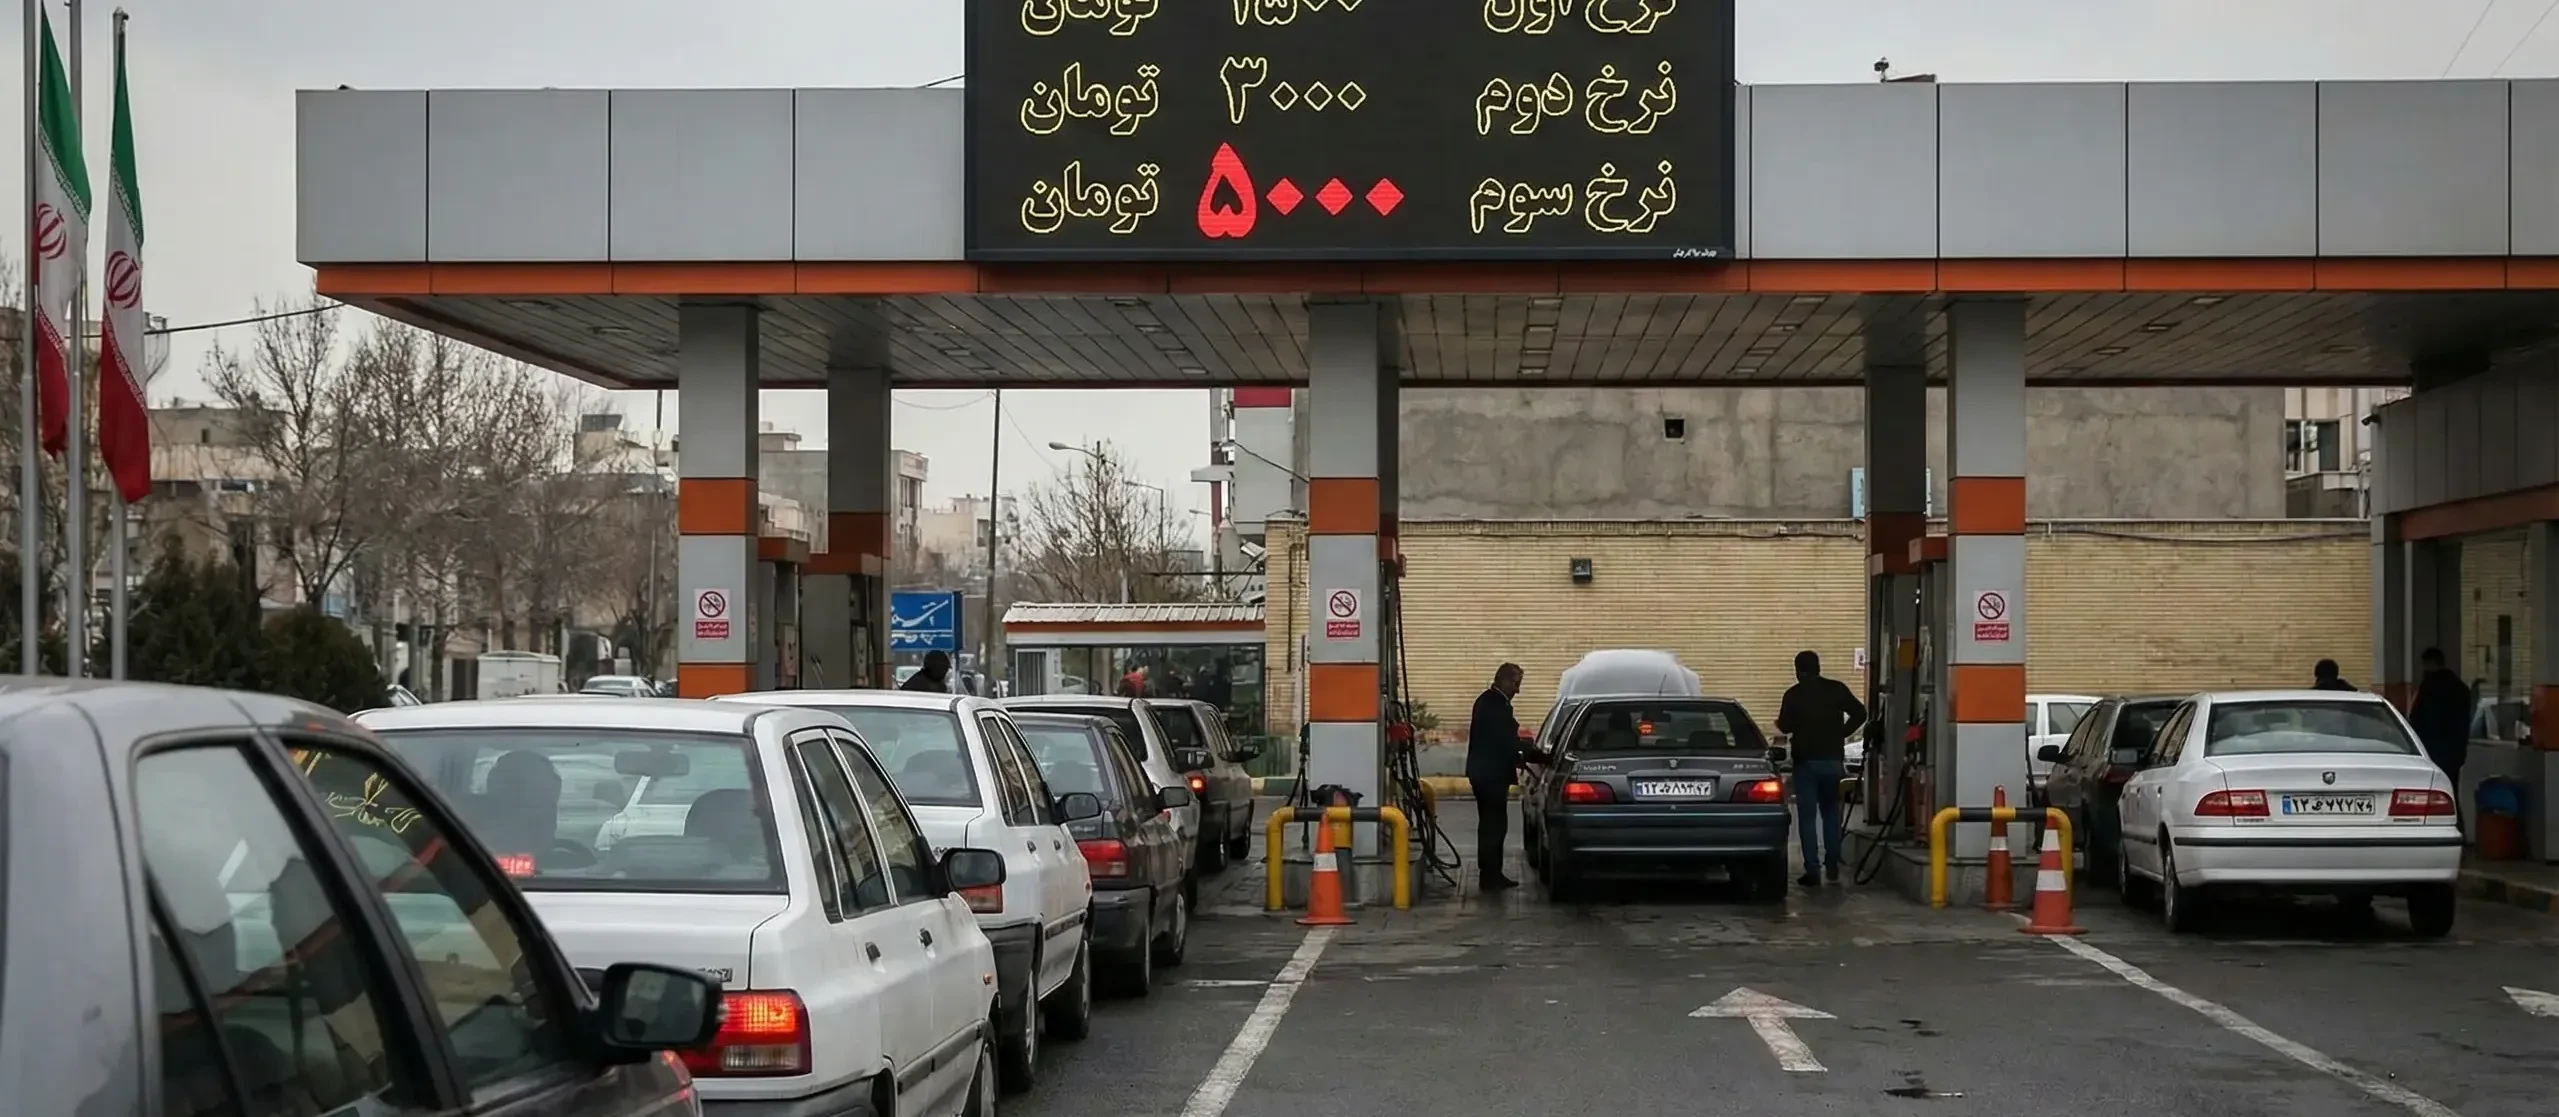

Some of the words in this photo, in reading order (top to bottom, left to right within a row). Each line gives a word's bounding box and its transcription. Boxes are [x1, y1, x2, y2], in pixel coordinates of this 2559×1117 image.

[1021, 62, 1160, 135] تومان
[1219, 57, 1367, 124] ۳۰۰۰
[1475, 72, 1574, 135] دوم
[1584, 61, 1677, 133] نرخ
[1021, 161, 1160, 233] تومان
[1196, 142, 1405, 239] ۵۰۰۰
[1469, 178, 1574, 233] سوم
[1584, 160, 1677, 232] نرخ
